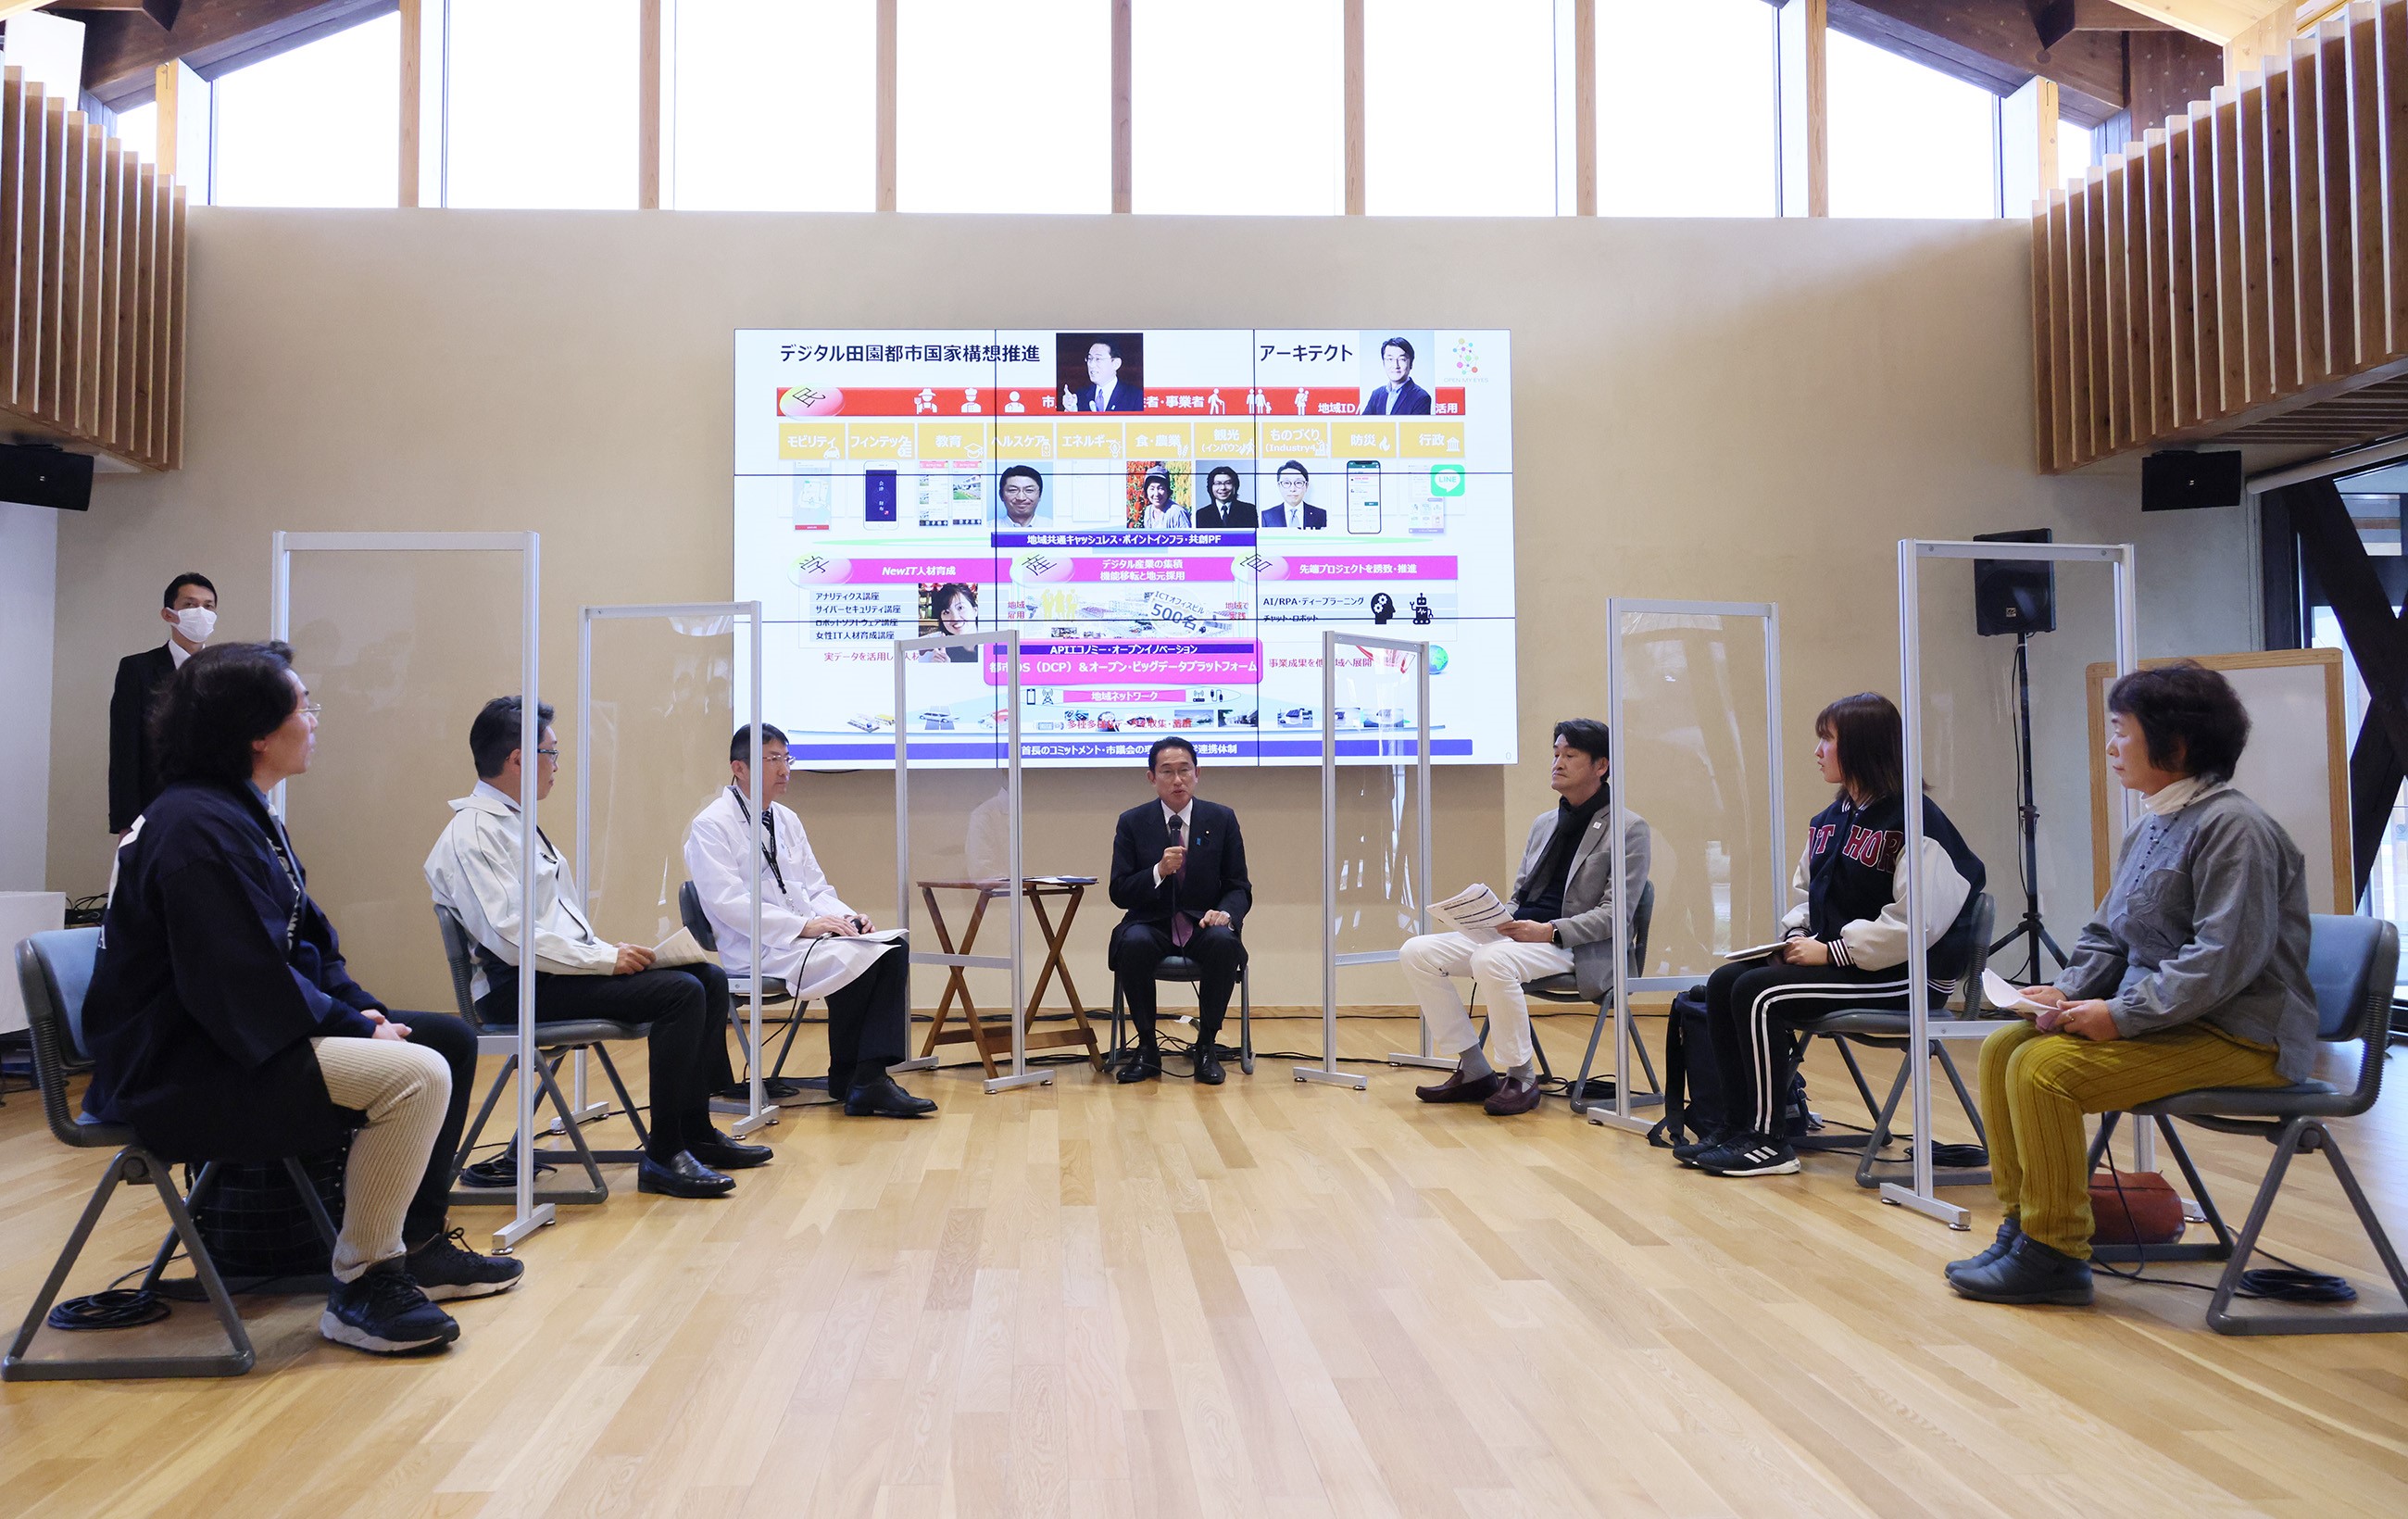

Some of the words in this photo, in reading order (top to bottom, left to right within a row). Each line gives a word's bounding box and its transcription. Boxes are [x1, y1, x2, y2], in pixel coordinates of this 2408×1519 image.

[781, 344, 1041, 362] デジタル田園都市国家構想推進
[1260, 345, 1353, 361] アーキテクト
[935, 434, 962, 447] 教育
[992, 435, 1045, 447] ヘルスケア
[1135, 434, 1181, 447] 食・農業
[1213, 429, 1239, 441] 観光
[1271, 429, 1320, 442] ものづくり
[1350, 434, 1375, 446] 防災
[1419, 433, 1445, 446] 行政
[787, 435, 836, 448] モビリティ
[1102, 559, 1184, 570] デジタル産業の集積
[882, 566, 957, 576] NewIT人材育成
[1100, 571, 1185, 582] 機能移転と地元採用
[816, 592, 880, 601] アナリティクス講座
[816, 605, 901, 614] サイバーセキュリティ講座
[1151, 603, 1198, 631] 500名
[816, 631, 895, 640] 女性IT人材育成講座
[1091, 691, 1159, 701] 地域ネットワーク
